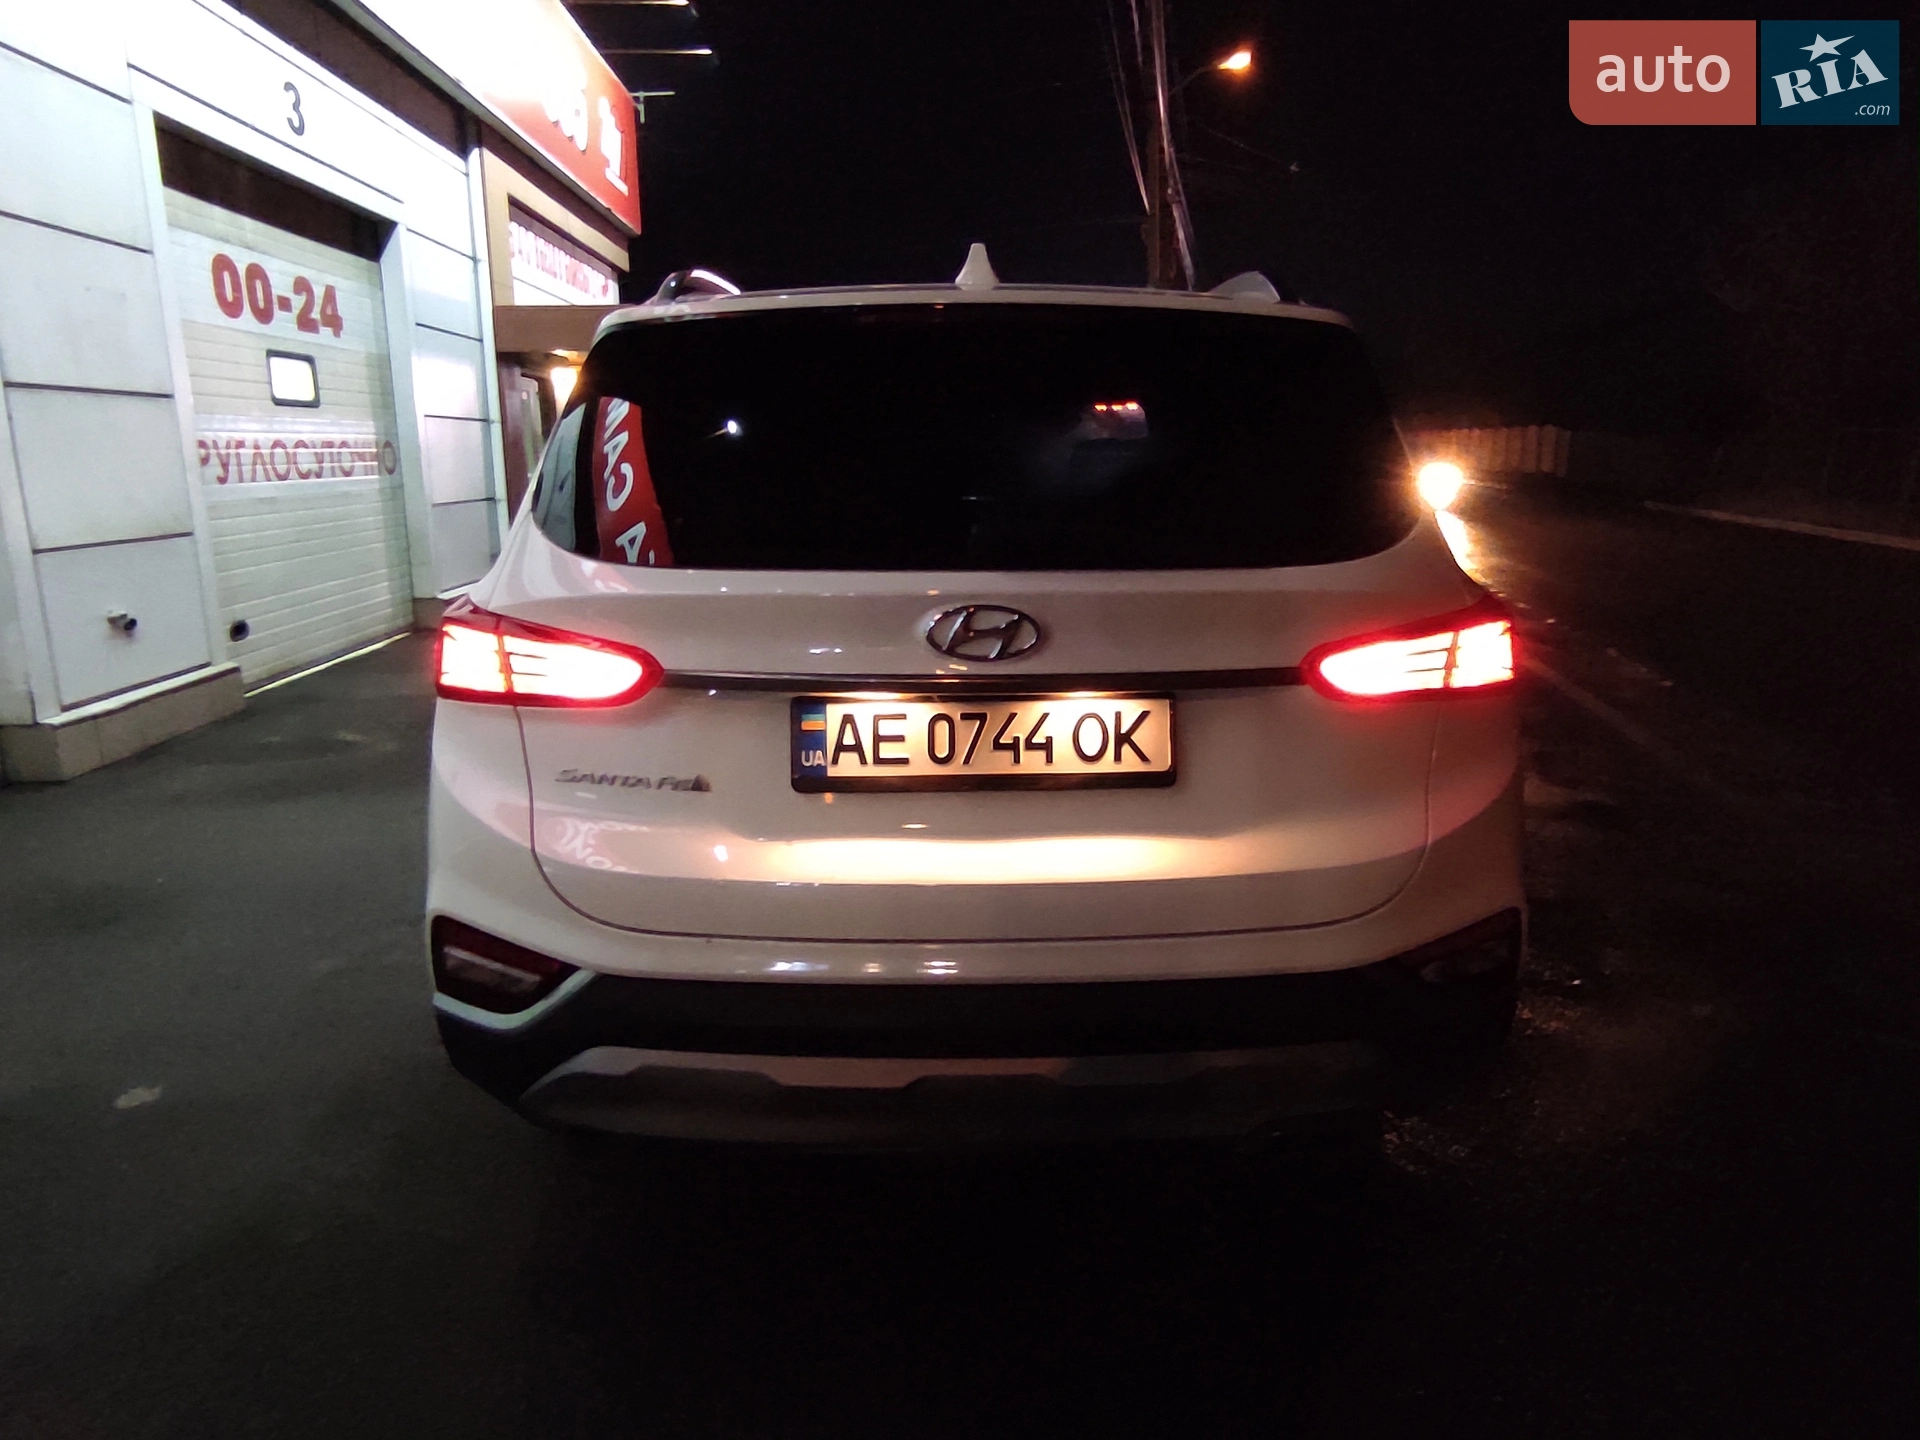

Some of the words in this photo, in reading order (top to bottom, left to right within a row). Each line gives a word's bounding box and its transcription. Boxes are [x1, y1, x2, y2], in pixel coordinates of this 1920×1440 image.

[283, 81, 305, 136] 3
[211, 253, 344, 338] 00-24
[801, 750, 825, 767] UA
[831, 713, 910, 765] AE
[927, 712, 1054, 765] 0744
[1072, 710, 1151, 763] OK
